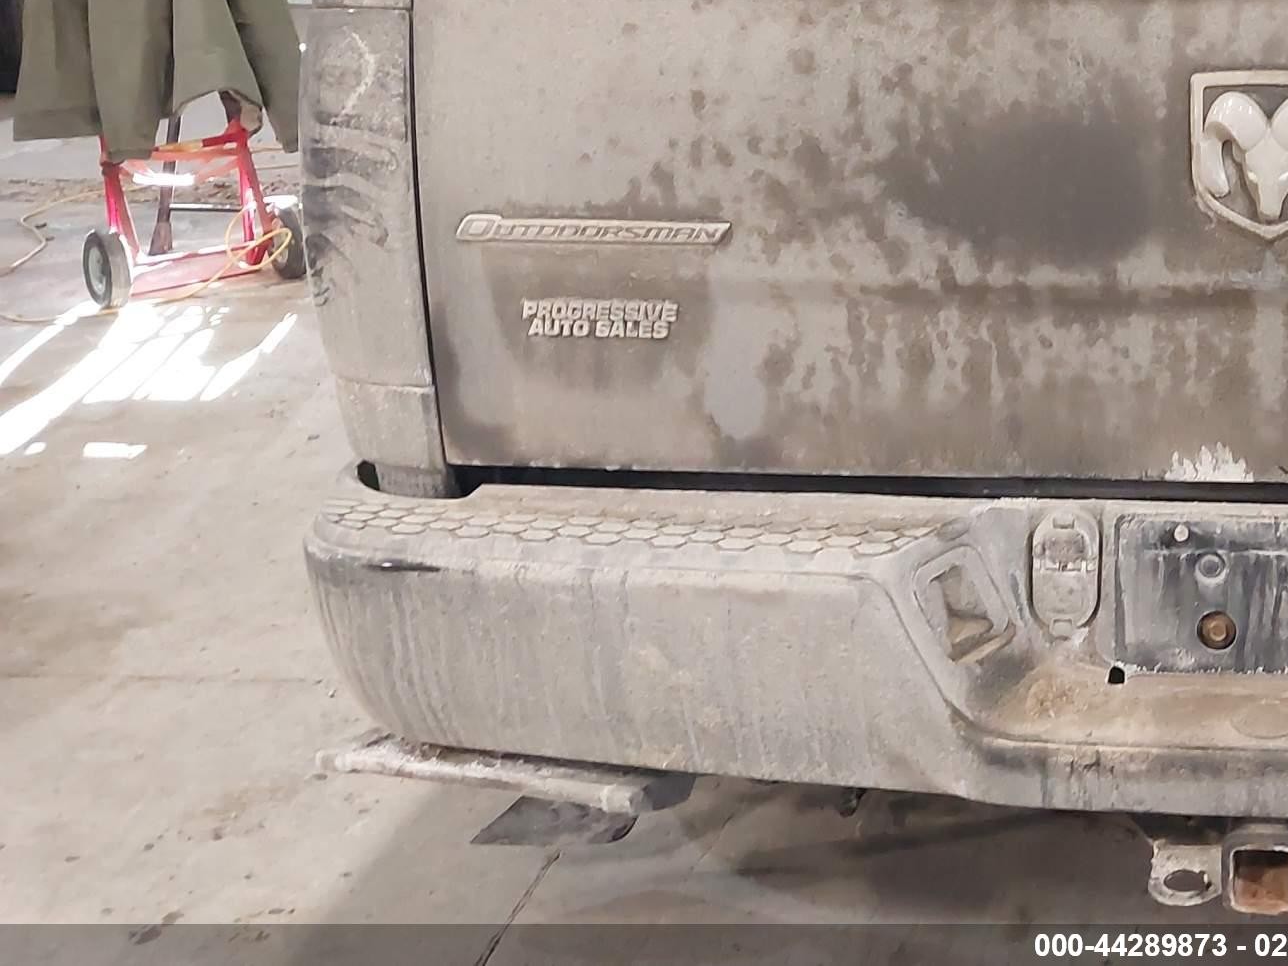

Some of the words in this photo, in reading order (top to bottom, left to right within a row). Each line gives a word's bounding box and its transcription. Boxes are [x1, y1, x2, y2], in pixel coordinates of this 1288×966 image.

[460, 215, 728, 244] OUTDOORSMAN
[521, 298, 680, 322] PROGRESSIVE
[528, 320, 590, 338] AUTO
[595, 321, 671, 340] SALES
